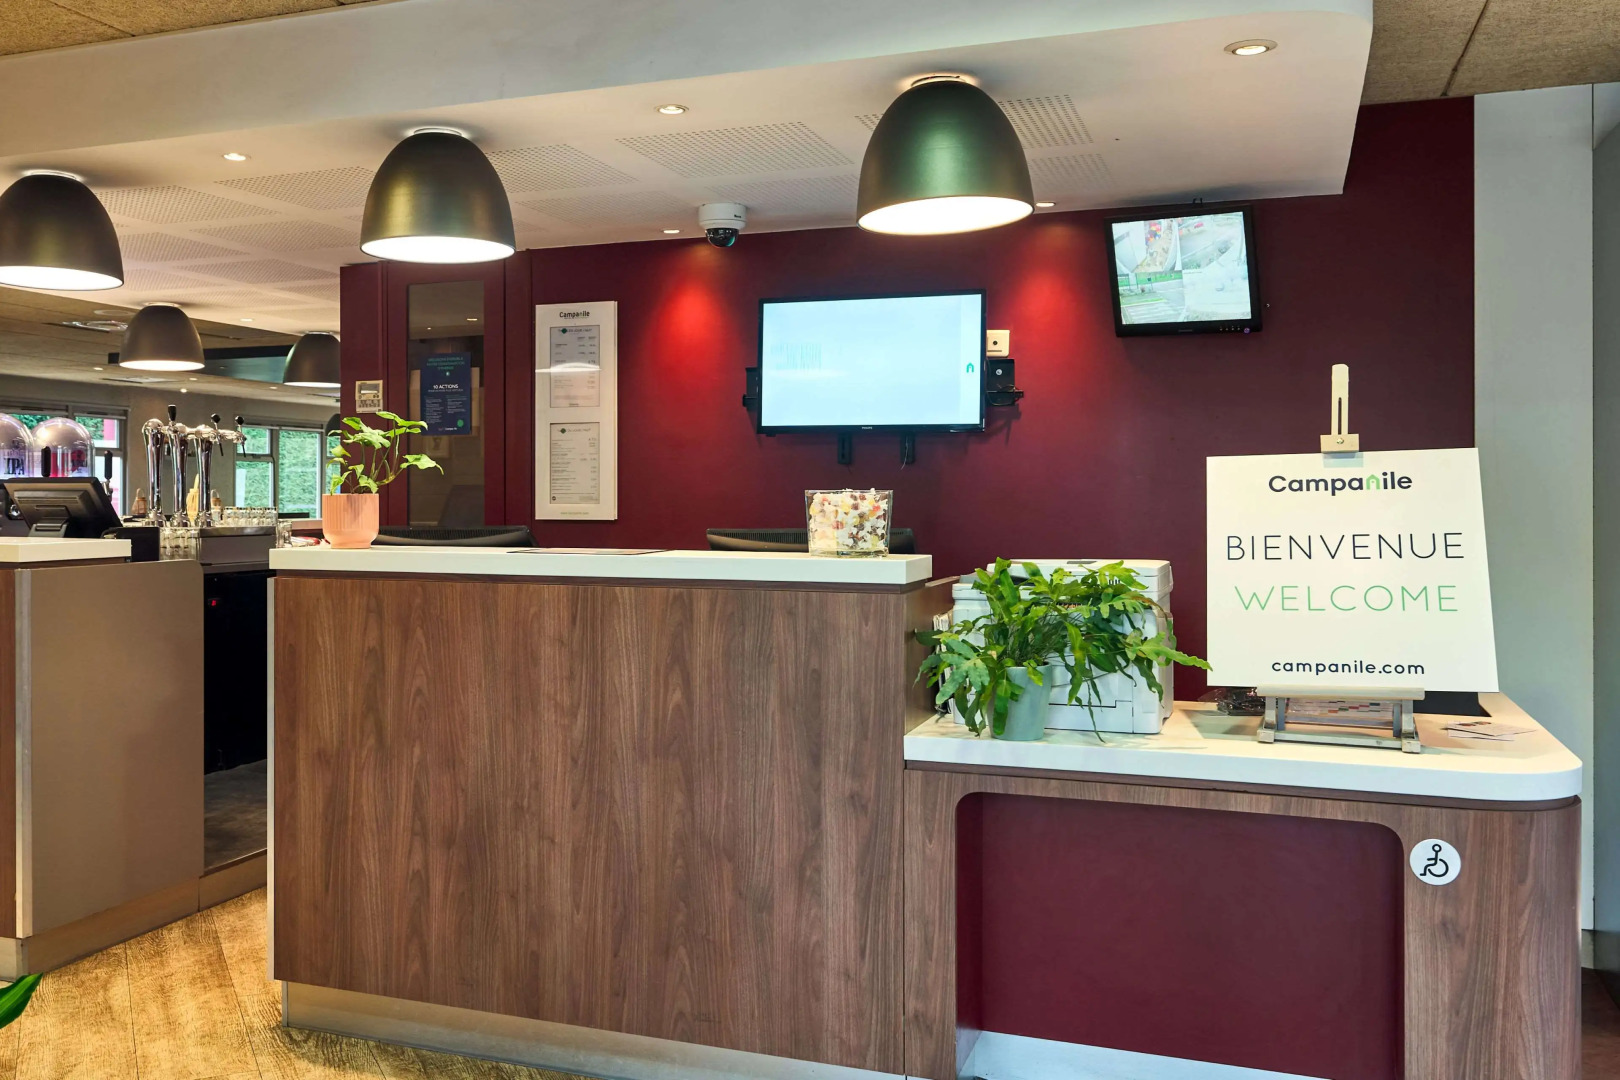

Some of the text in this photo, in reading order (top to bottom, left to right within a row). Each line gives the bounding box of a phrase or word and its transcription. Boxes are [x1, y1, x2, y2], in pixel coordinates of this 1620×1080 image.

[3, 457, 25, 474] IPA
[1268, 471, 1413, 497] Campanile
[1226, 532, 1465, 561] BIENVENUE
[1234, 585, 1459, 612] WELCOME
[1271, 660, 1426, 676] campanile.com
